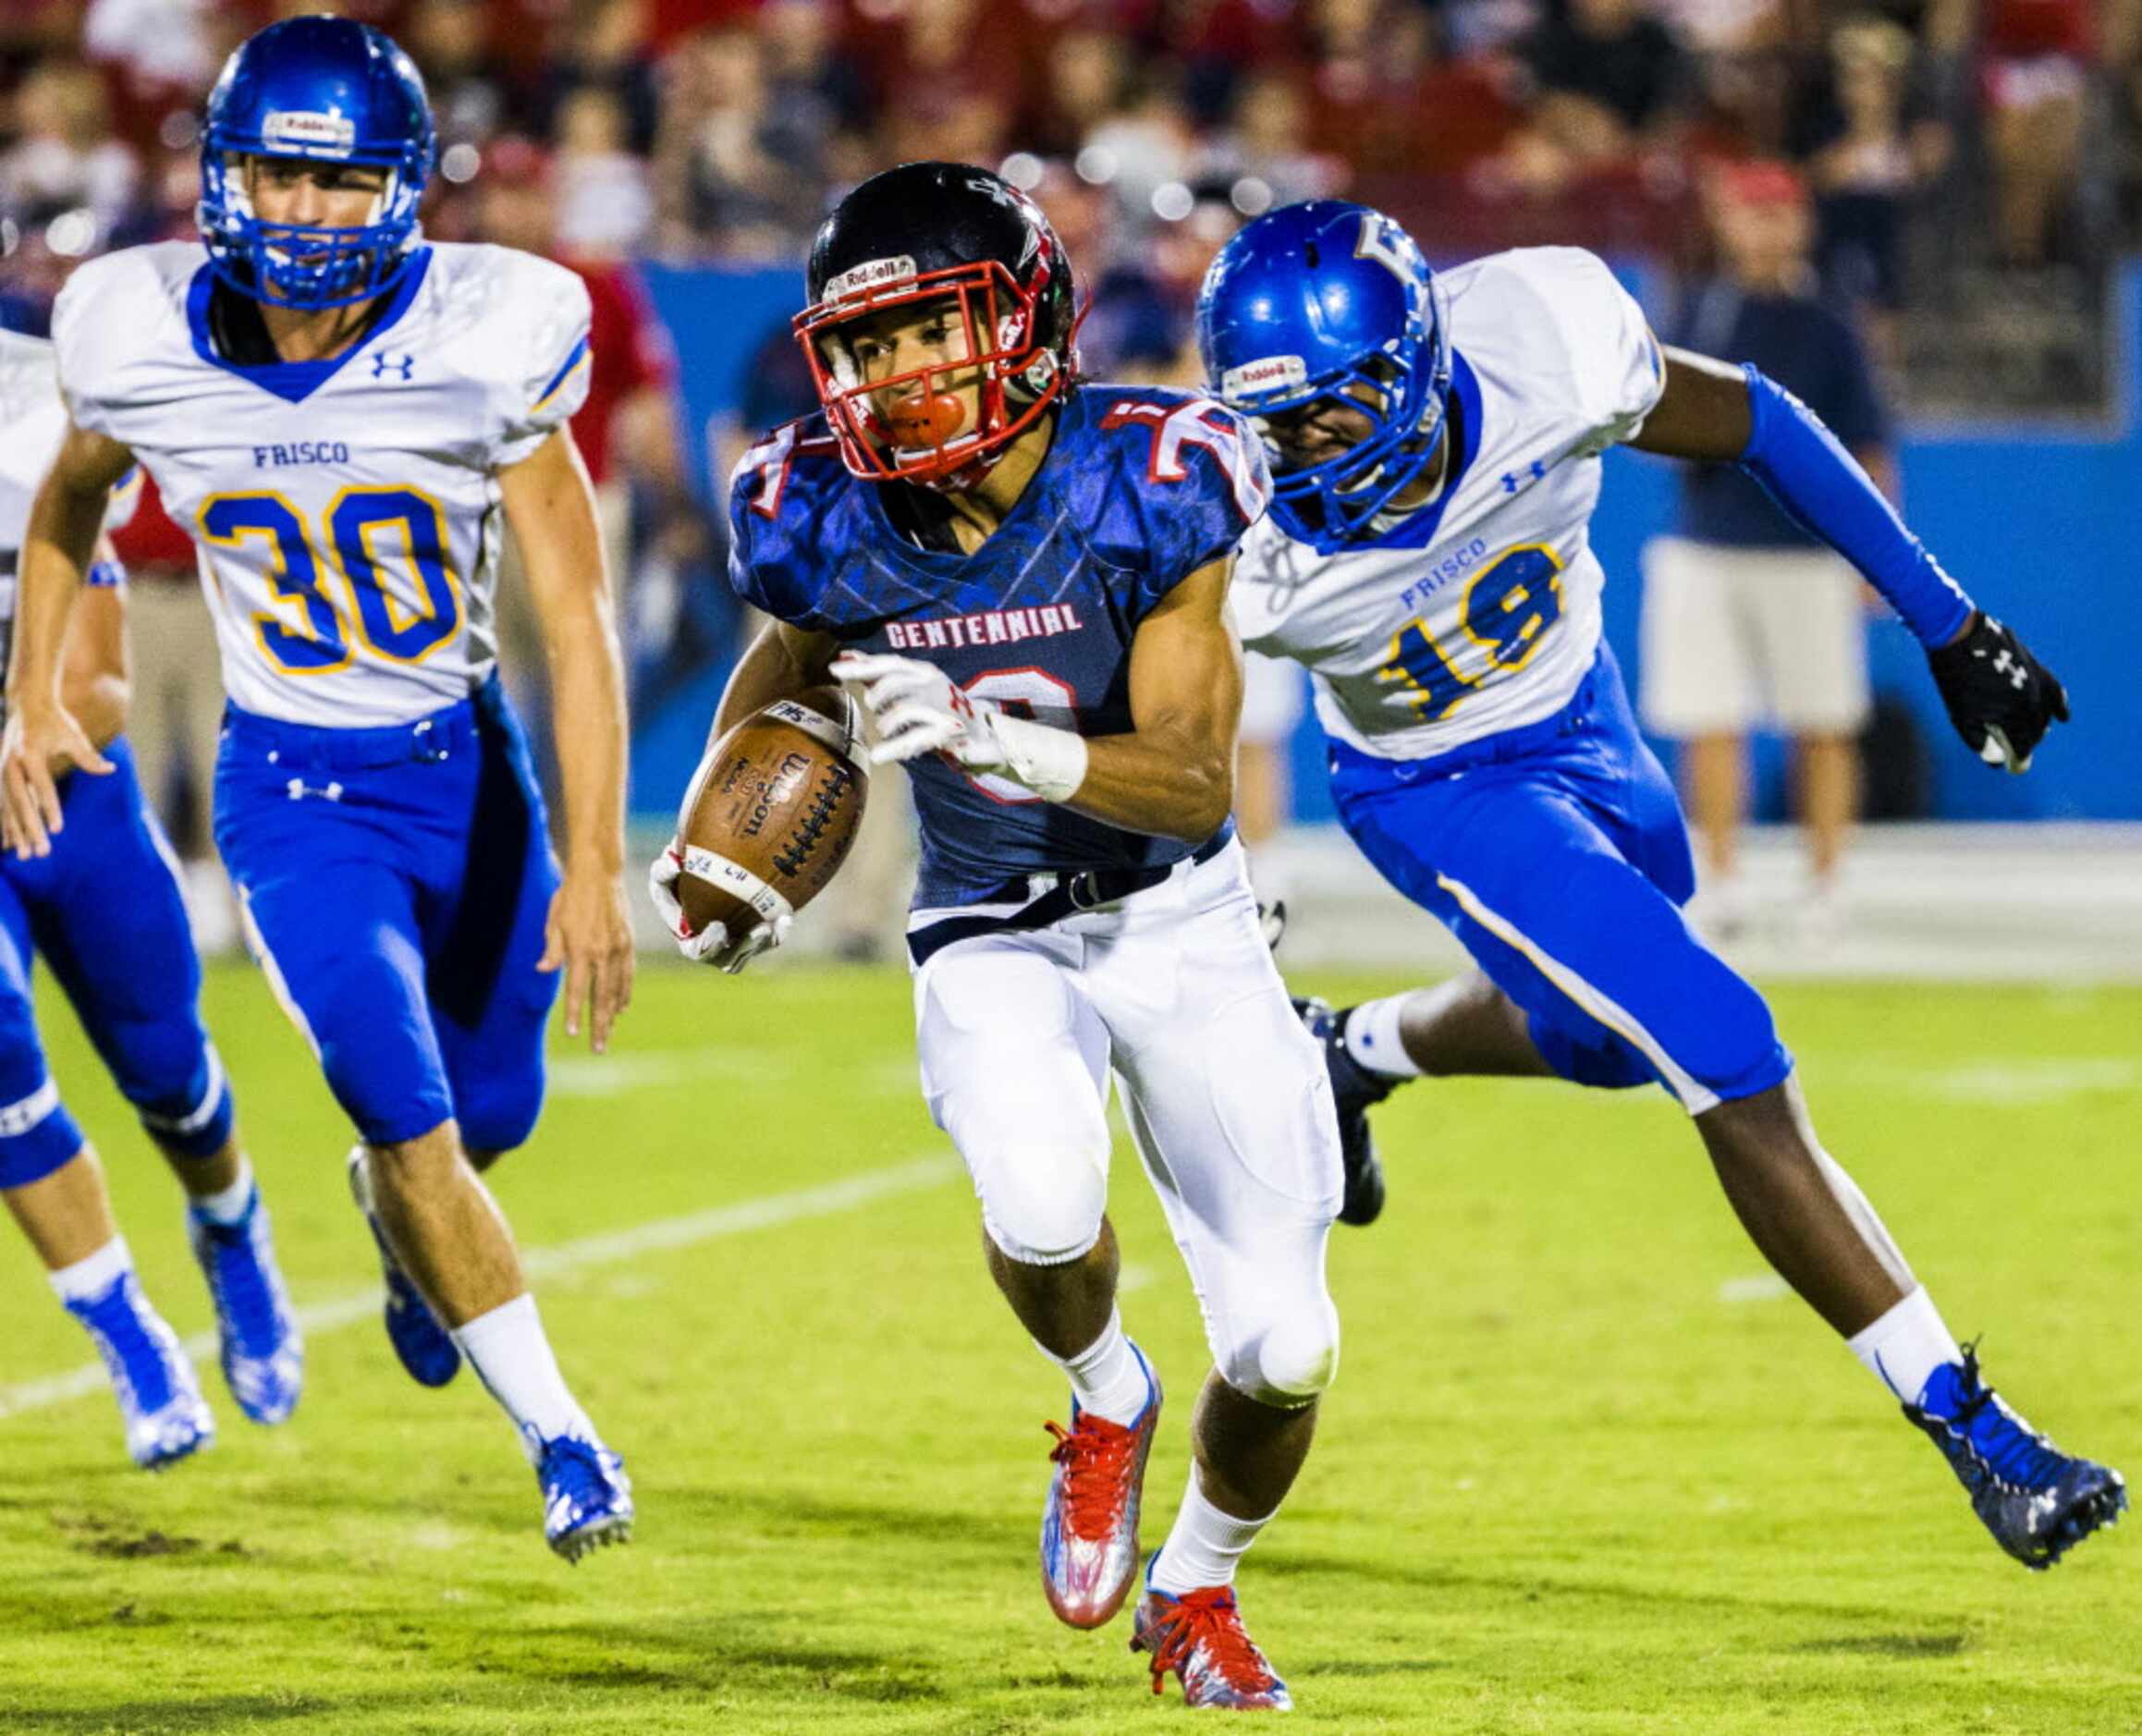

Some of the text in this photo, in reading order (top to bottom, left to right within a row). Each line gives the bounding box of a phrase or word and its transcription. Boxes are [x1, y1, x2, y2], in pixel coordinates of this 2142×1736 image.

[252, 442, 349, 468] FRISCO
[195, 482, 464, 675] 30
[1400, 537, 1487, 610] FRISCO
[885, 604, 1083, 649] CENTENNIAL
[743, 752, 812, 837] Wison
